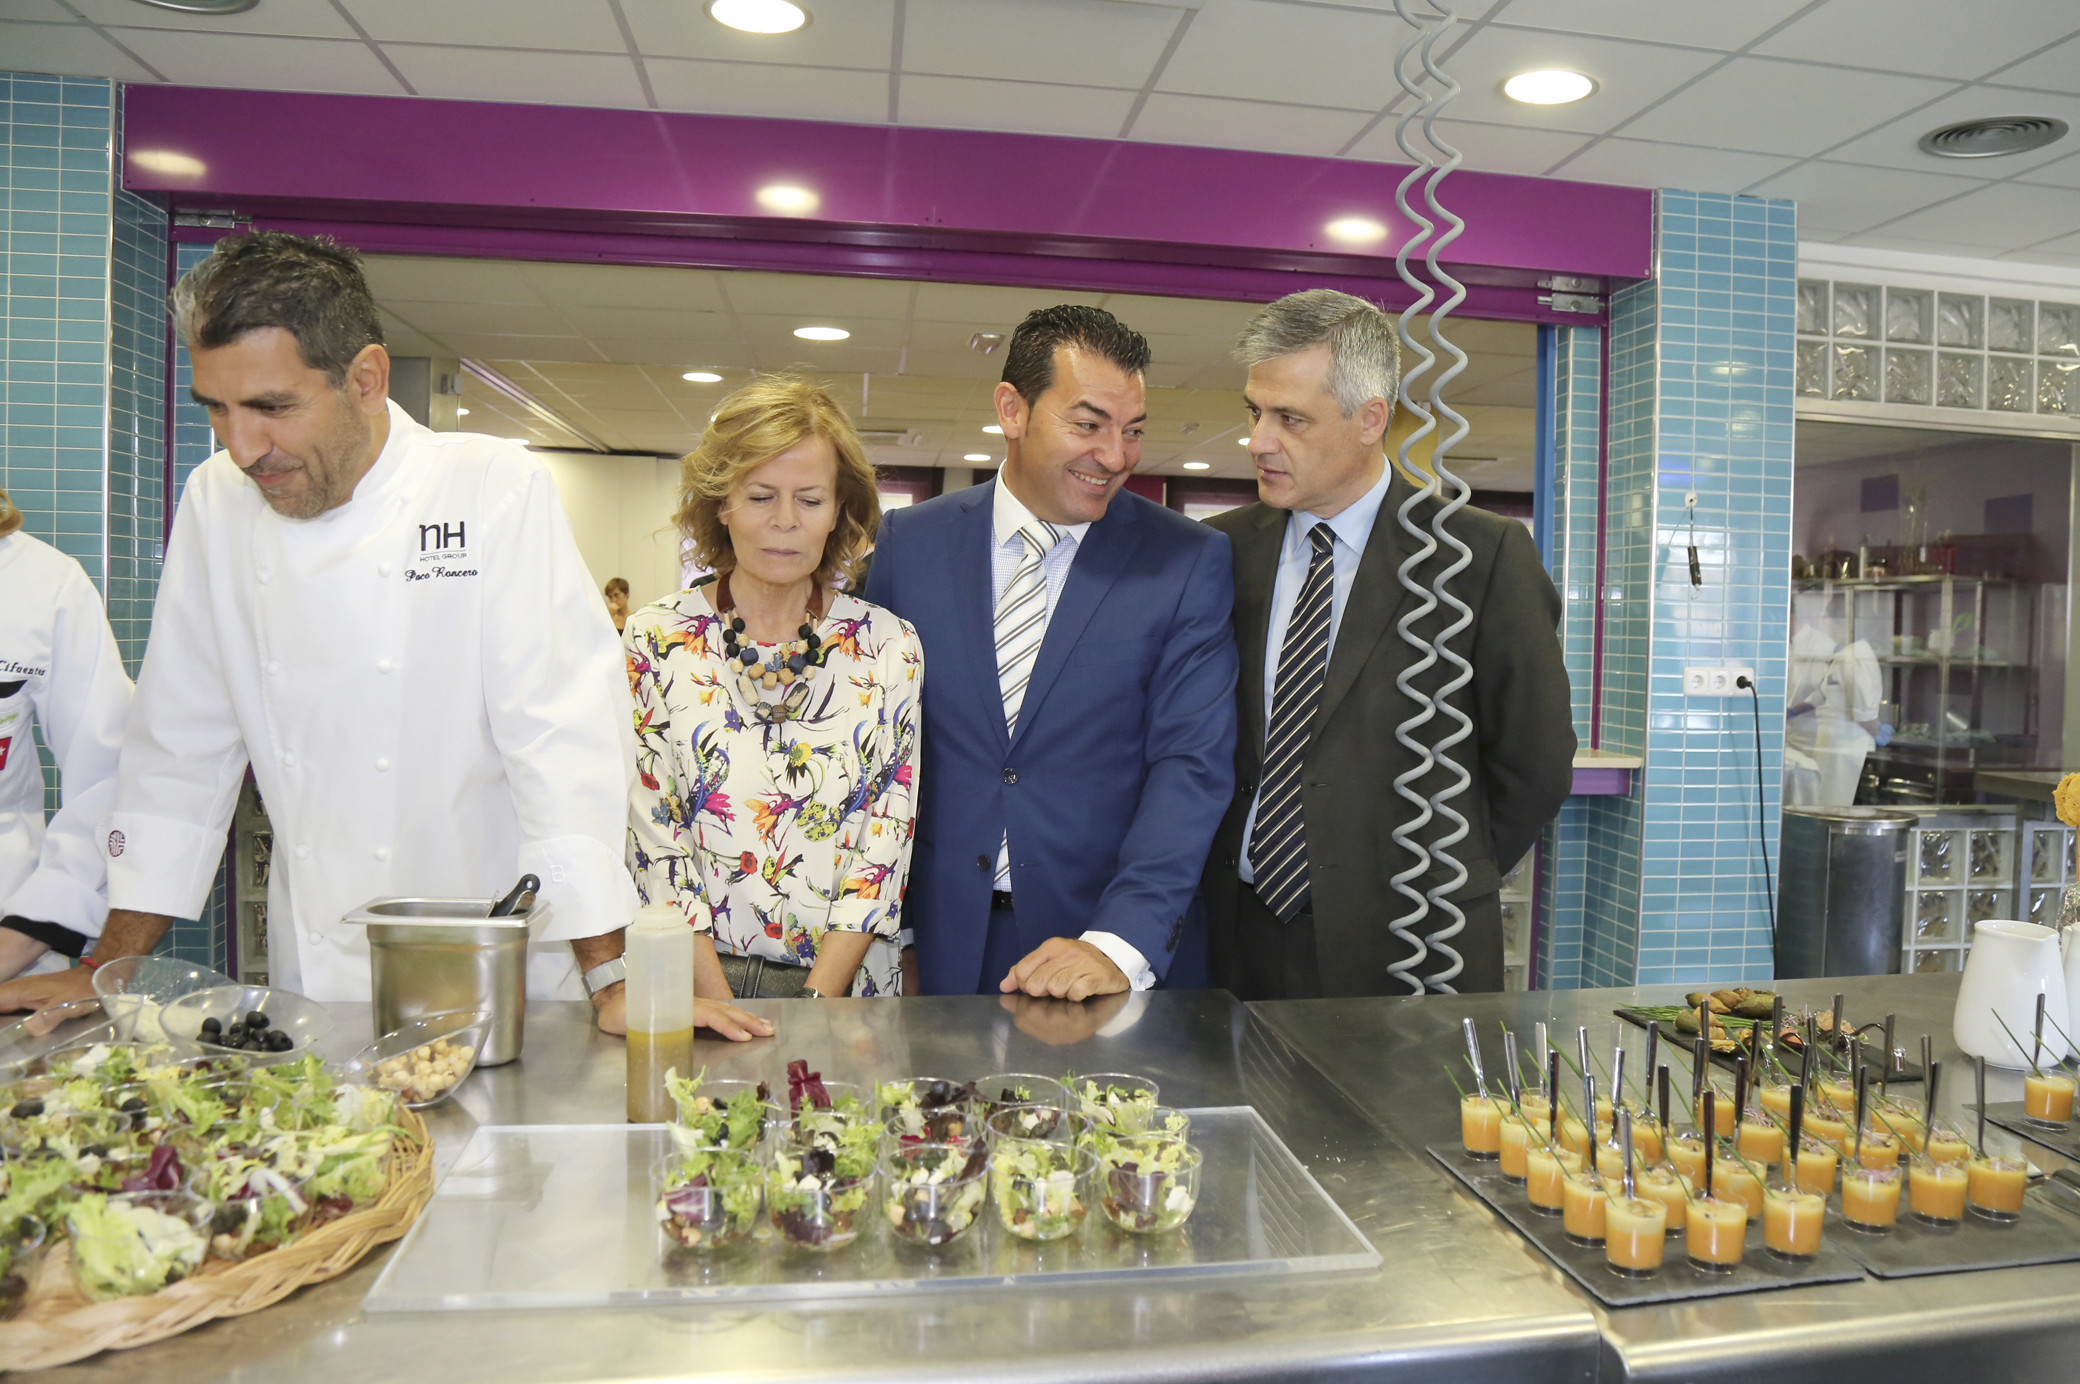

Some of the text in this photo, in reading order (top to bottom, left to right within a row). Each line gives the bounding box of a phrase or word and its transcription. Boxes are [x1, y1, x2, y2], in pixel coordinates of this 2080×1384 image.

[419, 552, 467, 562] HOTEL GROUP
[404, 566, 478, 582] Paco Roncero
[550, 864, 565, 883] B
